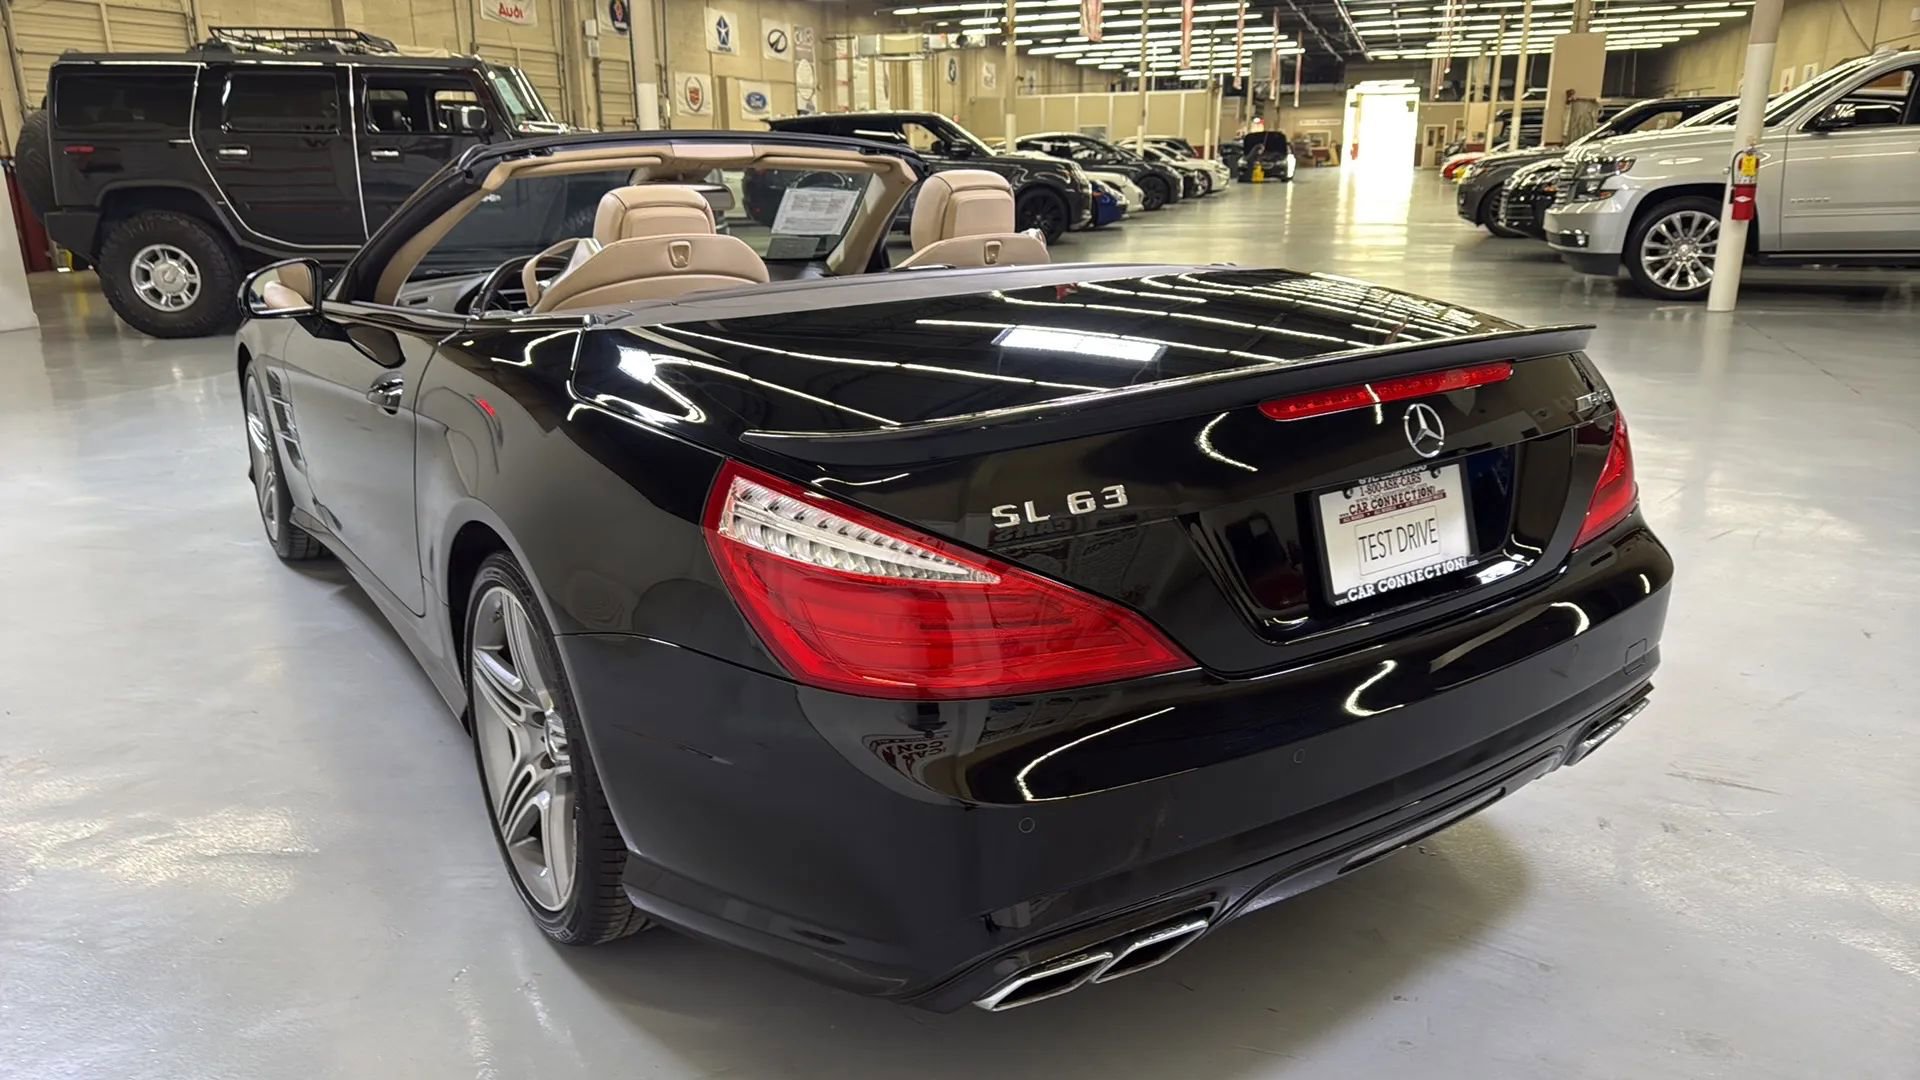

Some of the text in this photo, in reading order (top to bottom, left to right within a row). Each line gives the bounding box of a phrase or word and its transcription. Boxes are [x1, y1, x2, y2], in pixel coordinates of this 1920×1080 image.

[991, 484, 1128, 528] SL 63
[1358, 518, 1438, 563] TEST DRIVE
